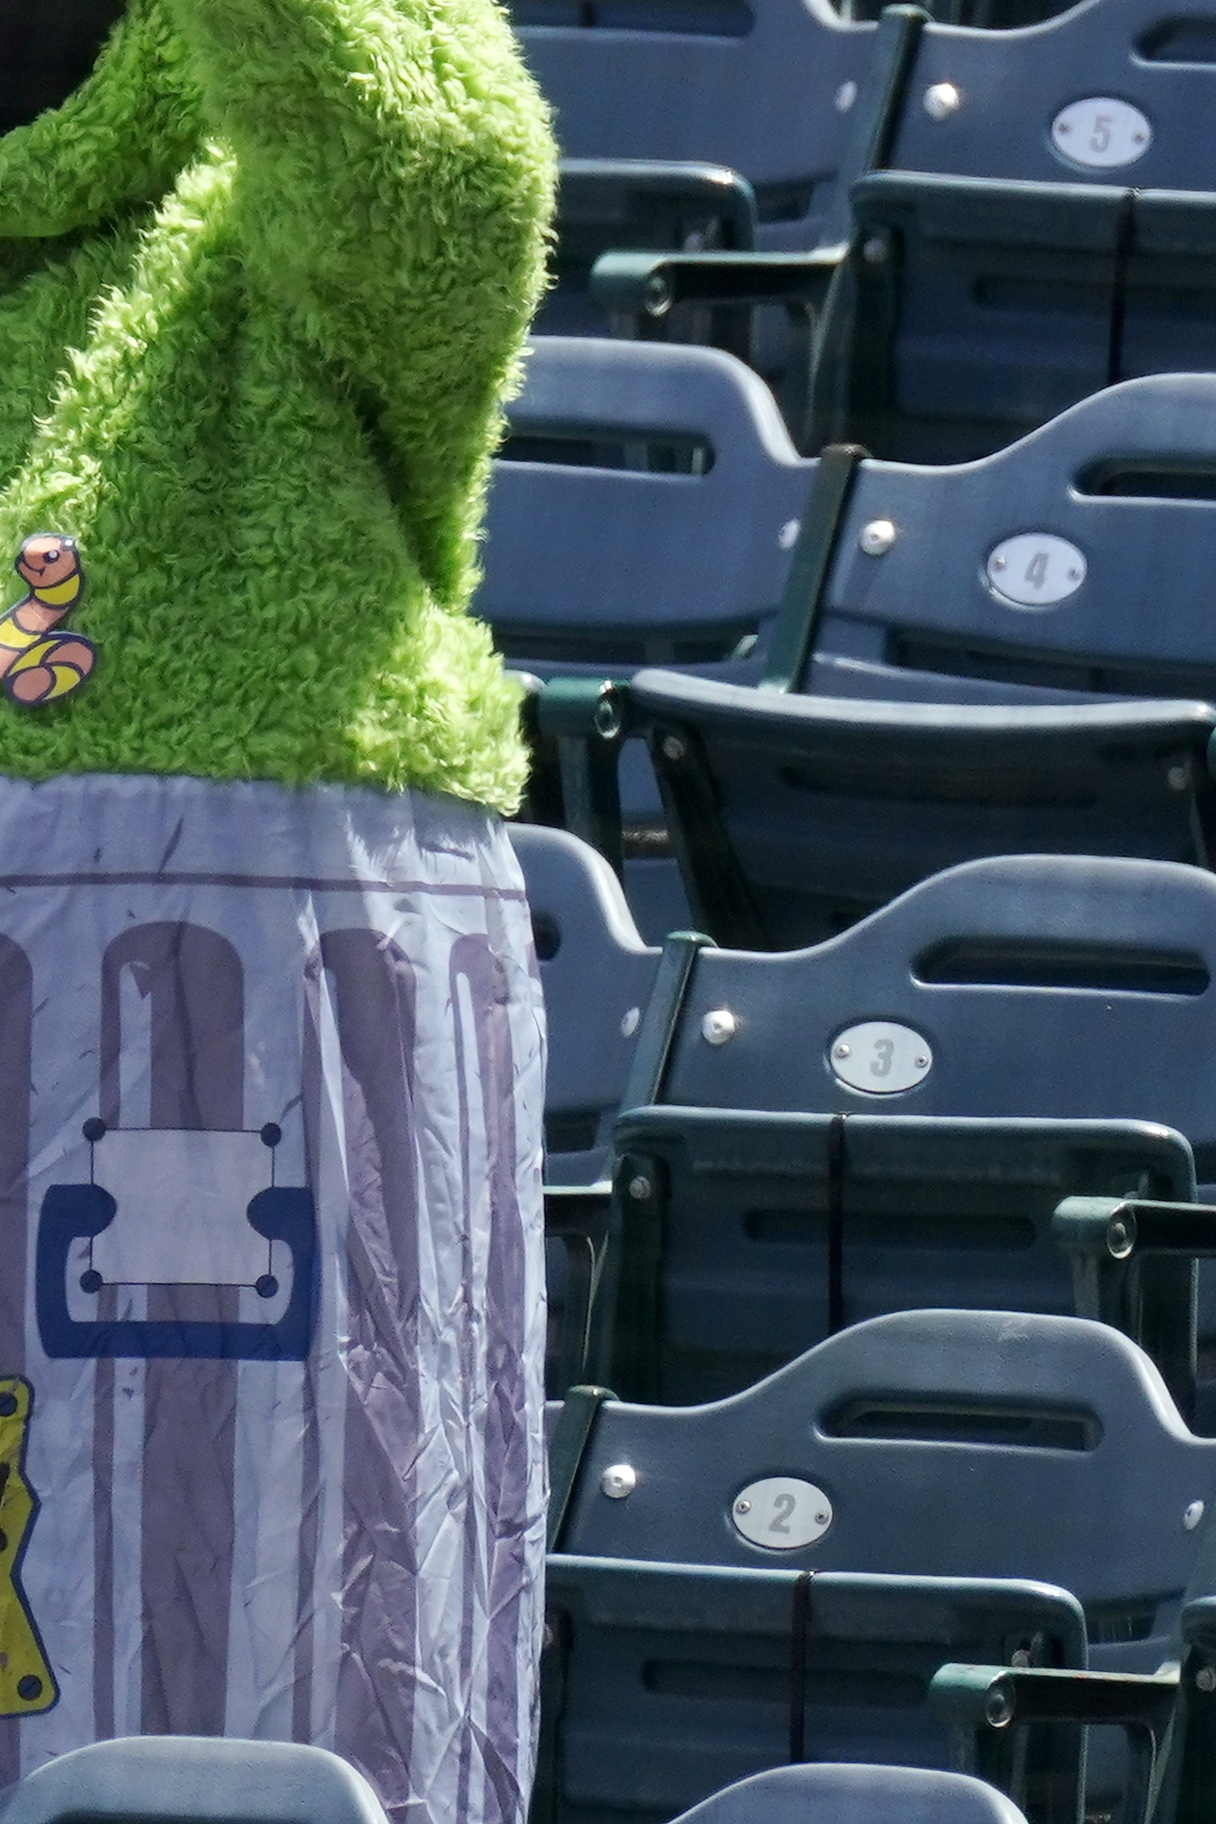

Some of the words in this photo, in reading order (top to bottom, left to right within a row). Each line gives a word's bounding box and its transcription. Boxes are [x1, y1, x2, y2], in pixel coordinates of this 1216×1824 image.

[1089, 115, 1113, 154] 5
[1024, 551, 1049, 590] 4
[870, 1037, 895, 1078] 3
[768, 1492, 797, 1535] 2
